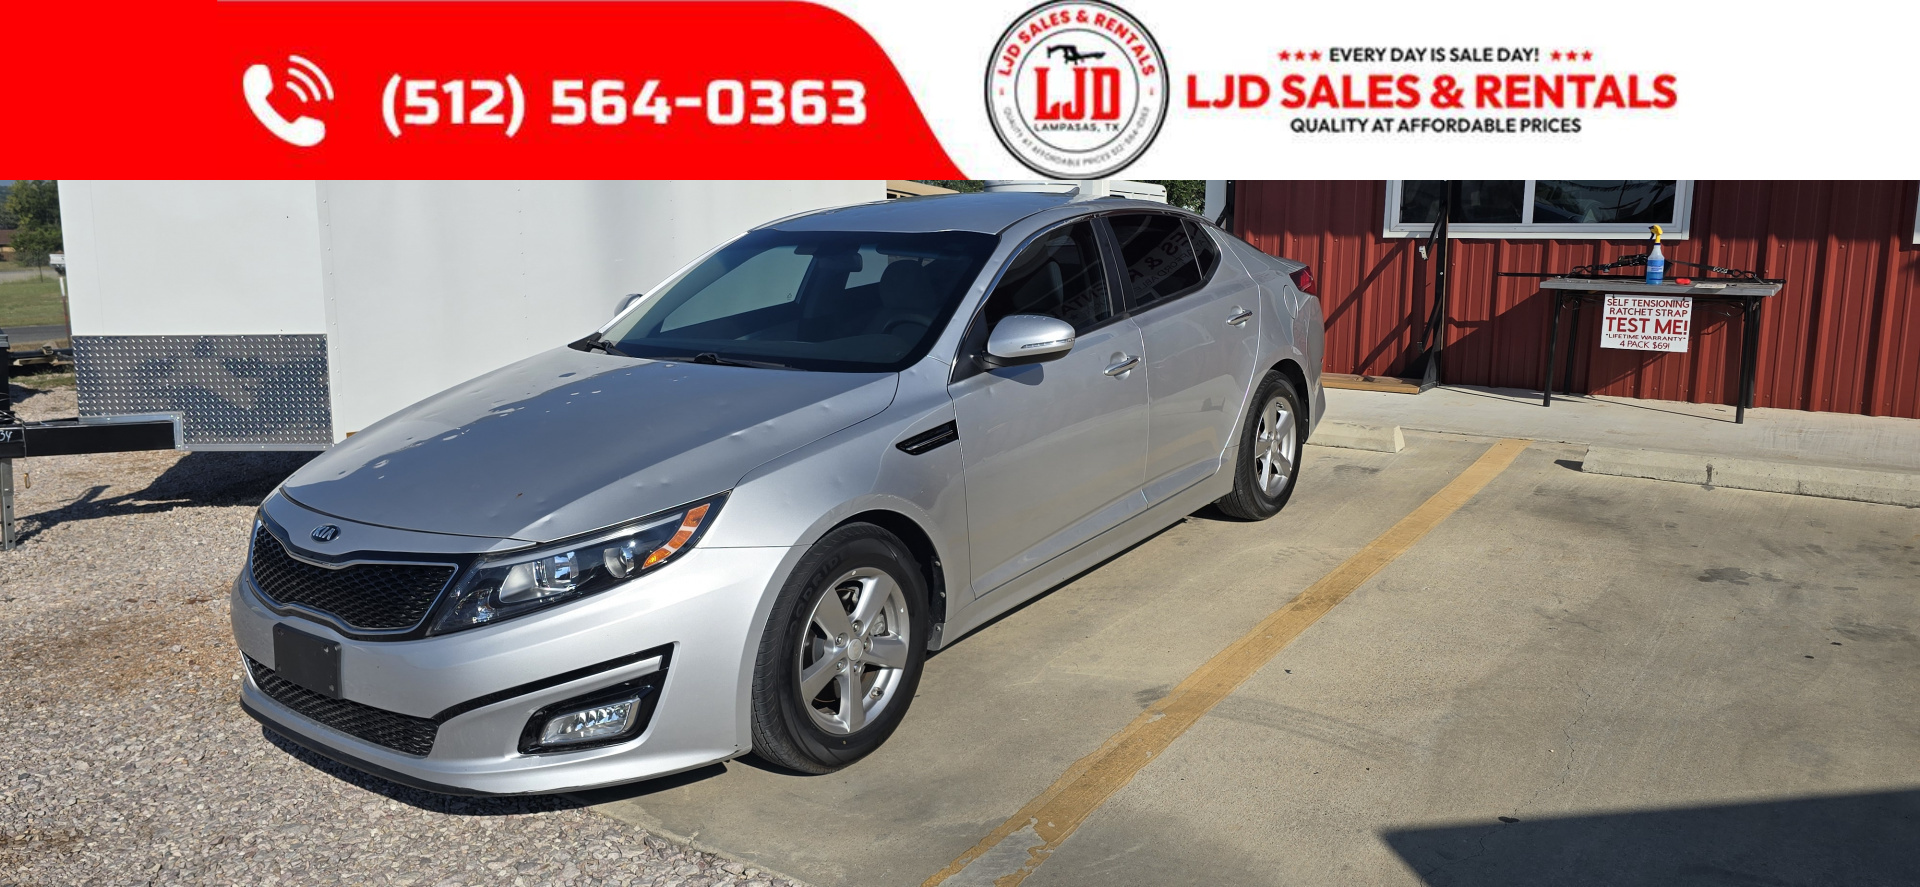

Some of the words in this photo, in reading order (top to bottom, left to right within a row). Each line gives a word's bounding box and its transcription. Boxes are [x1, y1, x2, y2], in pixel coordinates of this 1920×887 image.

[1607, 298, 1629, 307] SELF
[1632, 299, 1690, 308] TENSIONING
[1609, 307, 1653, 316] RATCHET
[1655, 309, 1688, 317] STRAP
[1606, 316, 1650, 333] TEST
[1654, 318, 1688, 335] ME!
[1627, 340, 1650, 348] PACK
[1652, 341, 1670, 350] $69!
[312, 525, 336, 540] KIA
